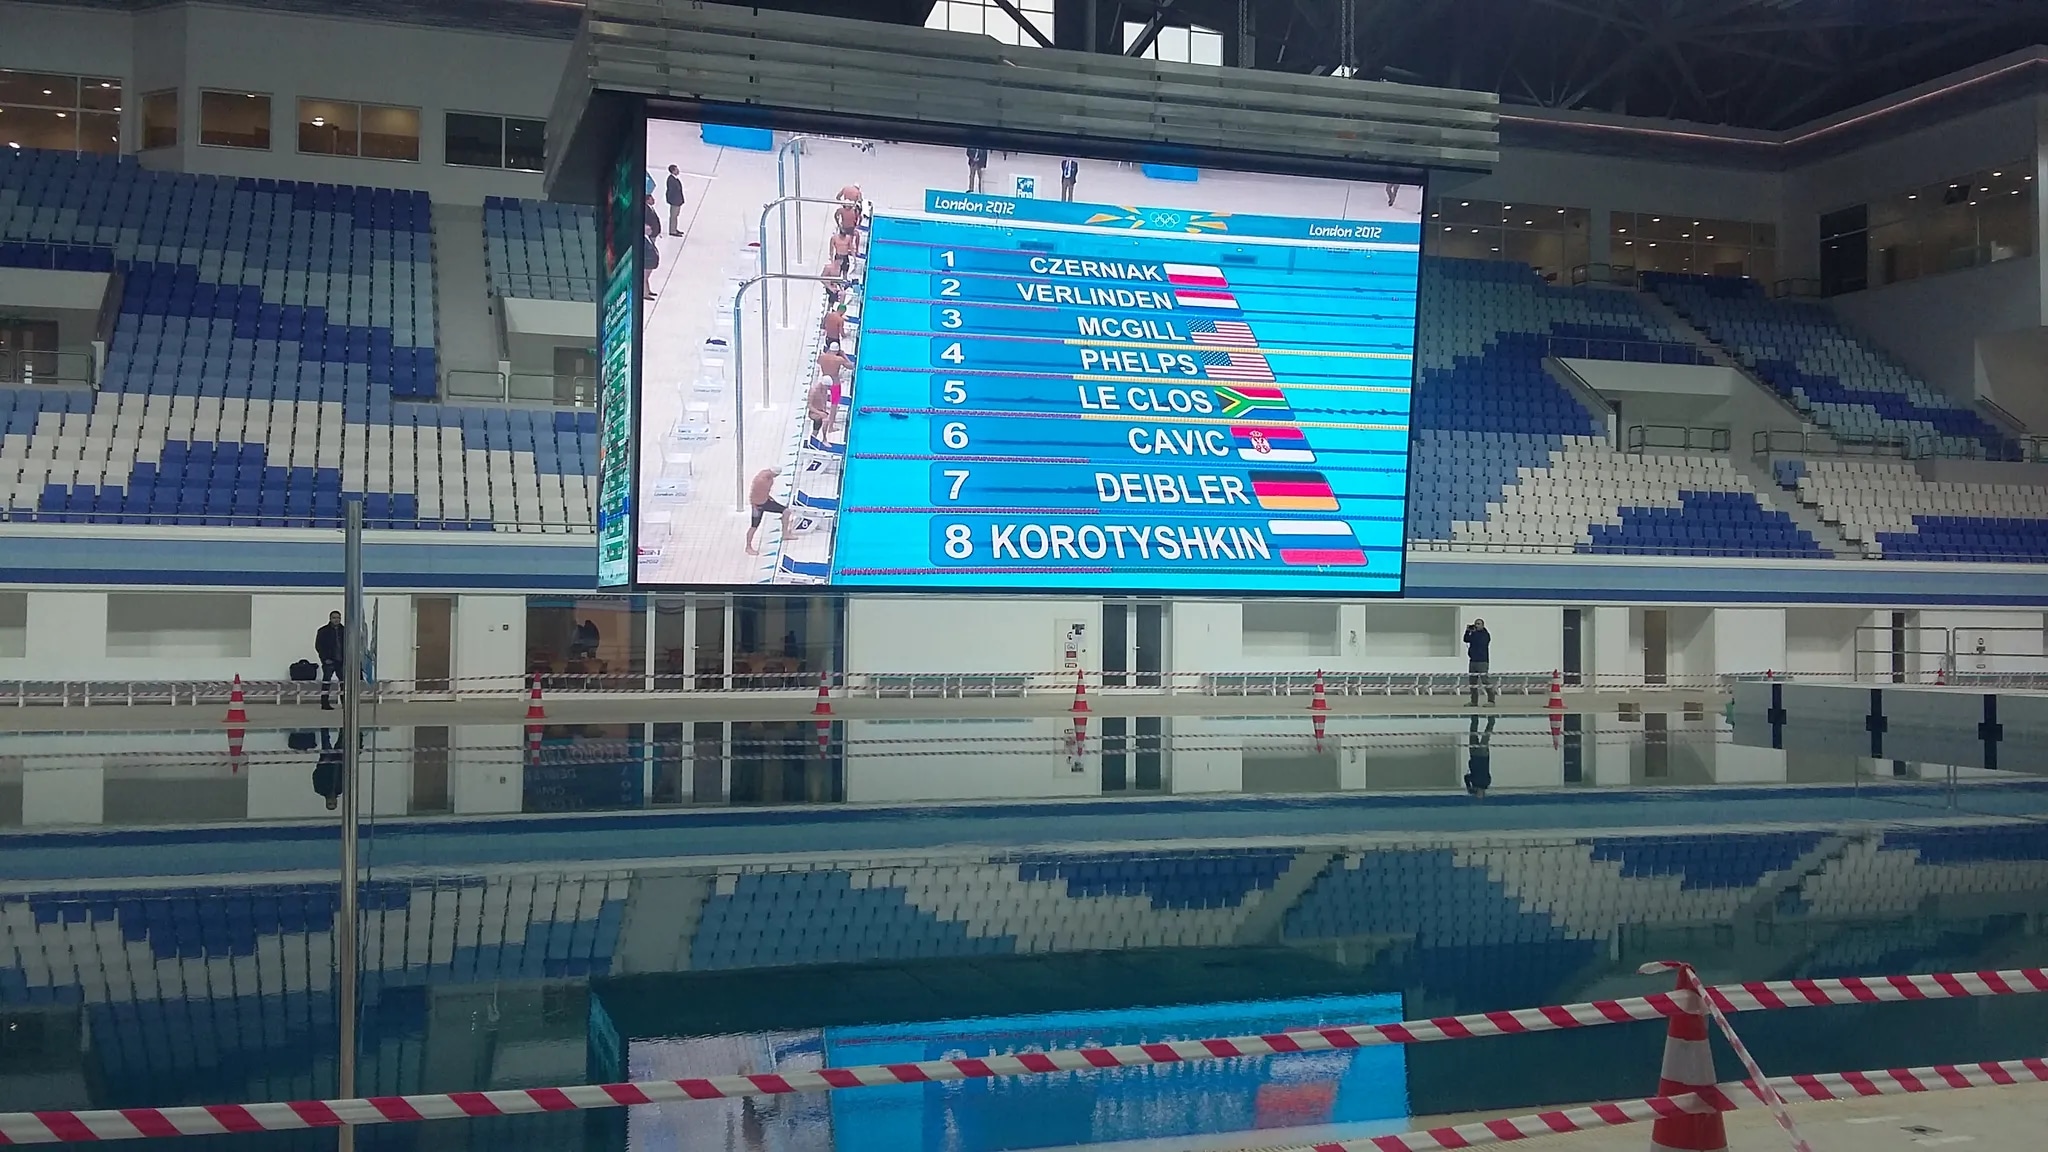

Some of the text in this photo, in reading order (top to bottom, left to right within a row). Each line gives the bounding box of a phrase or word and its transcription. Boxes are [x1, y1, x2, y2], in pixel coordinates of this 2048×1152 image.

[934, 196, 1016, 215] London 2012
[1309, 224, 1382, 239] London 2012
[941, 251, 1162, 282] 1 CZERNIAK
[941, 278, 1174, 310] 2 VERLINDEN
[942, 309, 1187, 342] 3 MCGILL
[941, 342, 1199, 376] 4 PHELPS
[943, 380, 1214, 414] 5 LE CLOS
[943, 422, 1230, 457] 6 CAVIC
[943, 470, 1251, 506] 7 DEIBLER
[944, 522, 1272, 561] 8 KOROTYSHKIN
